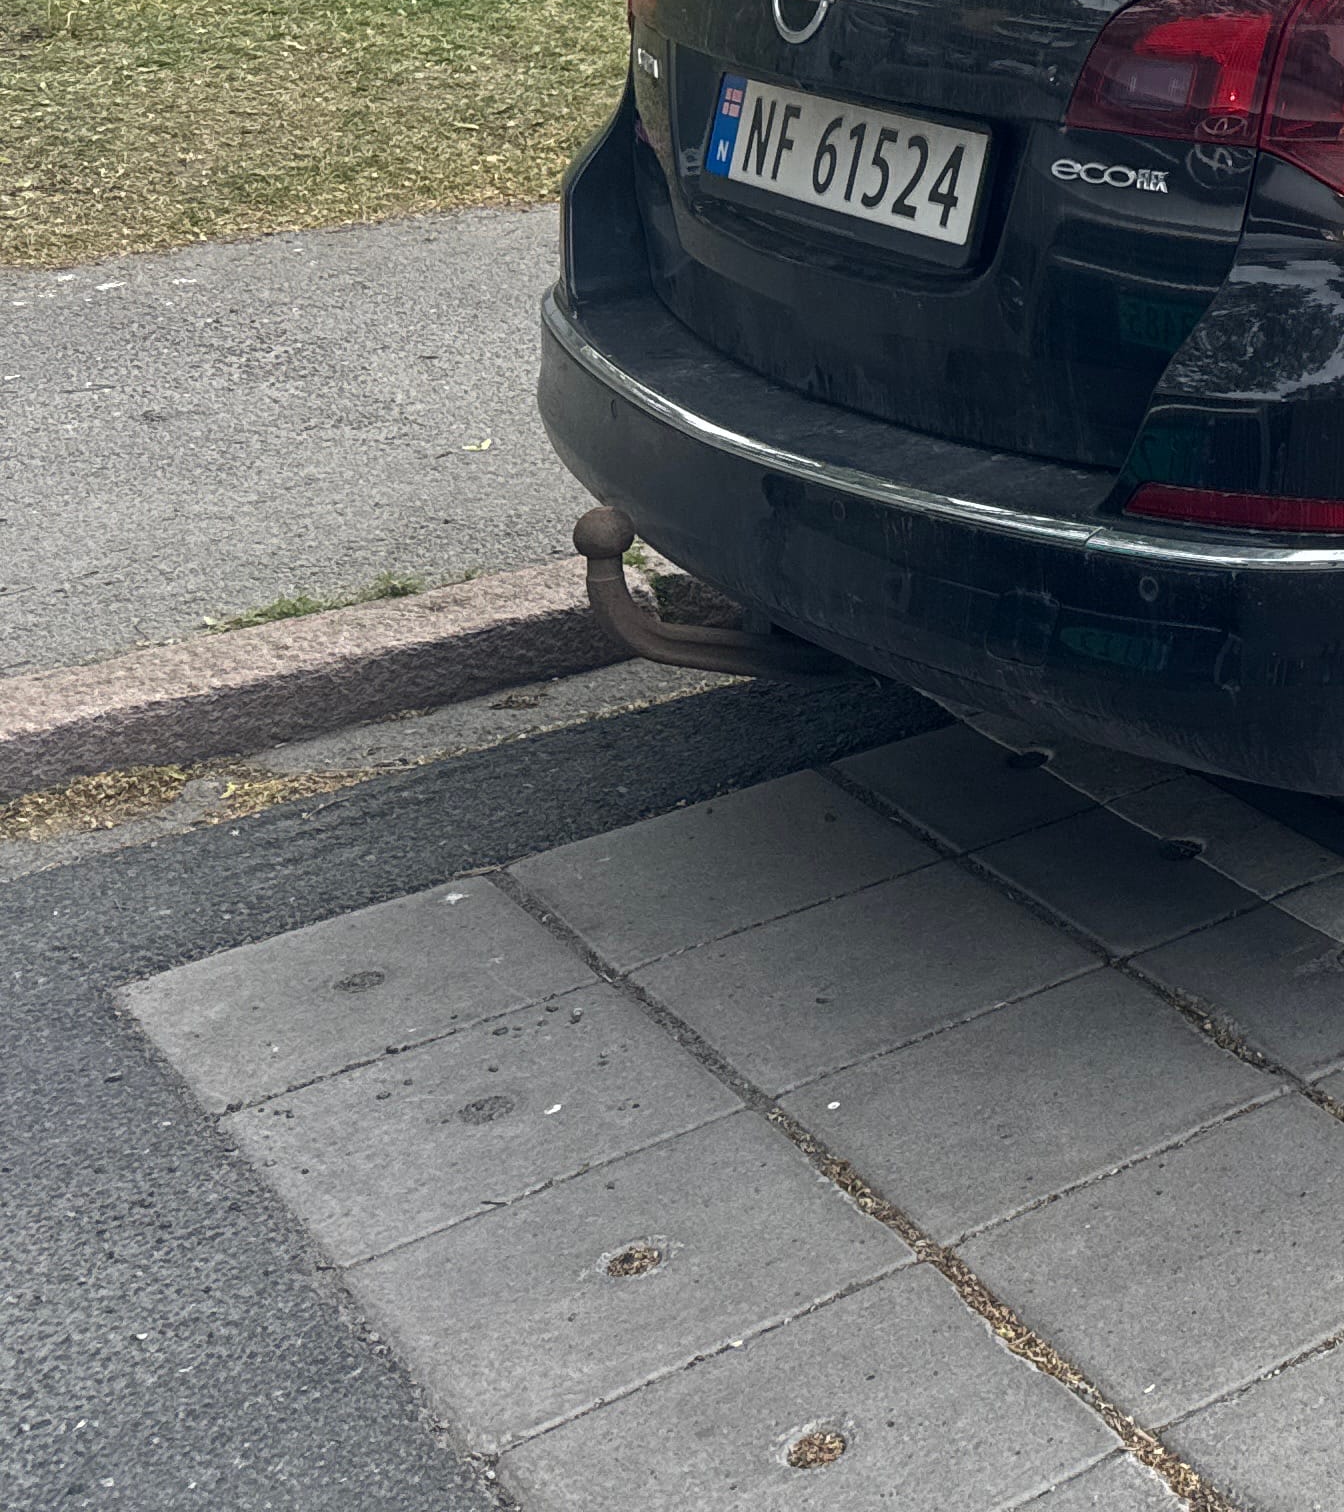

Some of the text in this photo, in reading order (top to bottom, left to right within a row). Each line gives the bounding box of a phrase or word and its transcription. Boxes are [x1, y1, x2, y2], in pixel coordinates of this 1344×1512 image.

[715, 138, 730, 163] N
[742, 95, 966, 230] NF 61524
